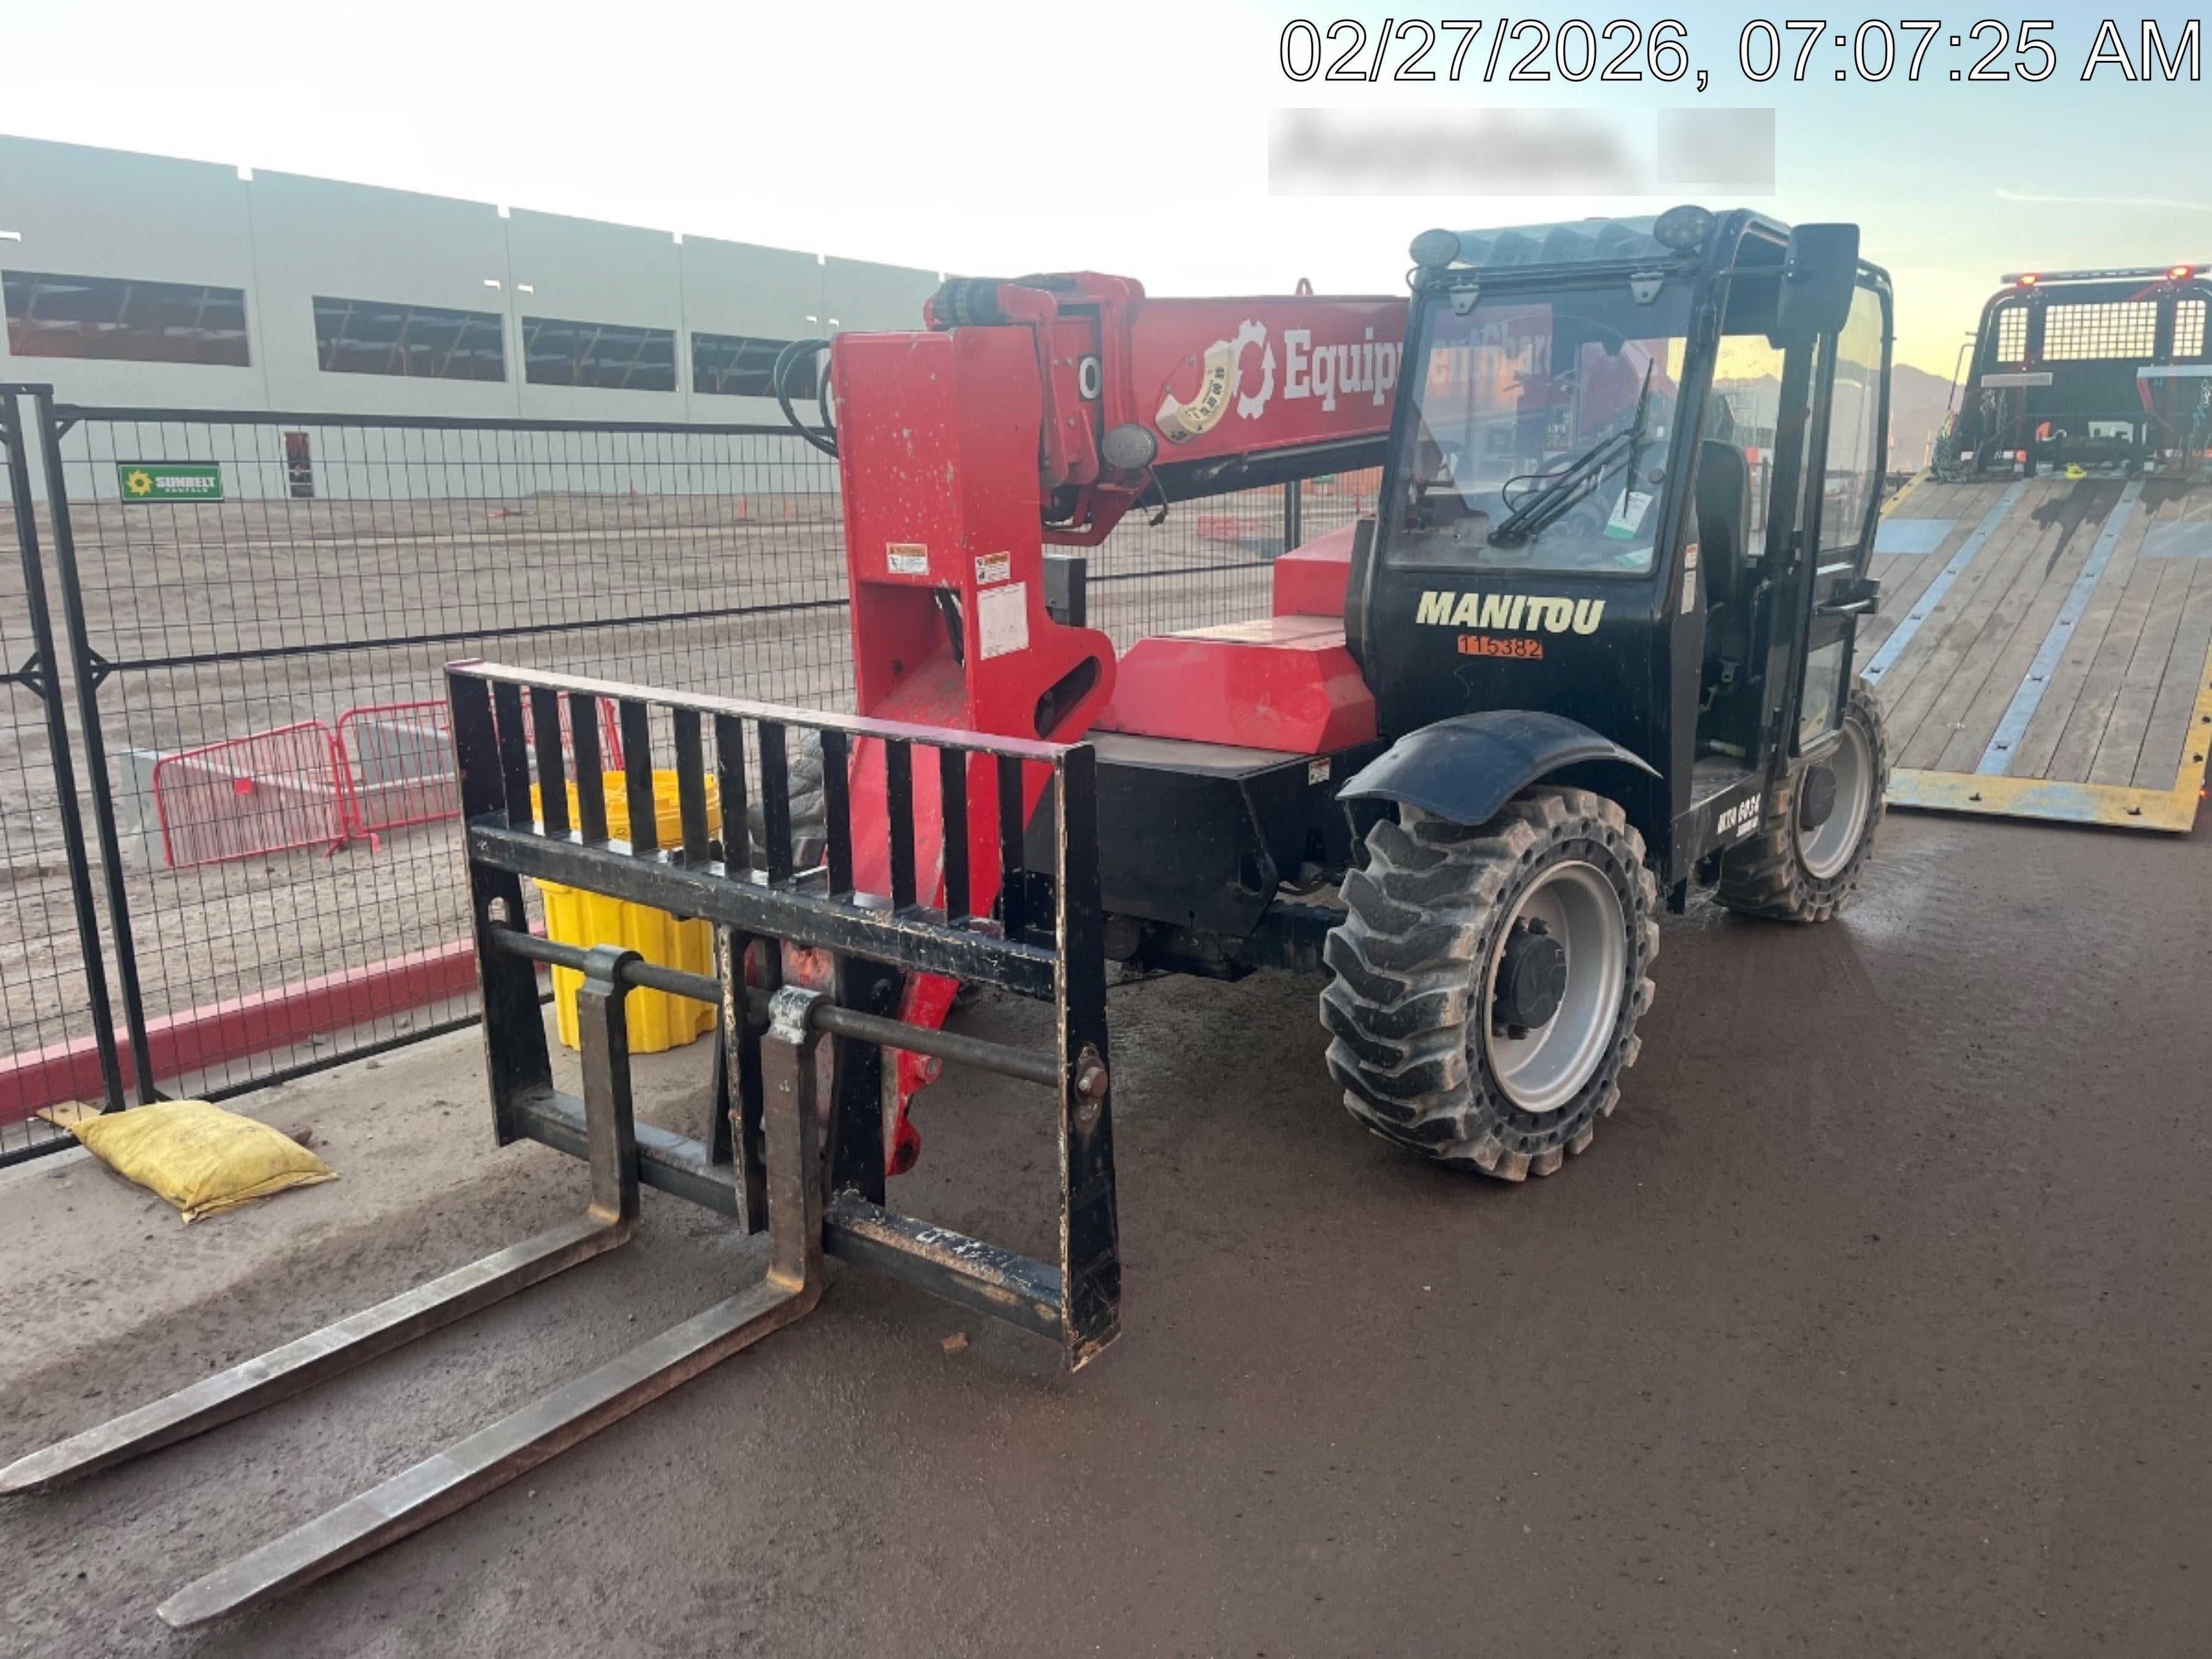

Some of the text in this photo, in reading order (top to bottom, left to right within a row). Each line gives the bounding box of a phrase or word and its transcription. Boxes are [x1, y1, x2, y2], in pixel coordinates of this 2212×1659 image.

[155, 476, 216, 488] SUNBELT
[1415, 591, 1606, 635] MANITOU
[1459, 635, 1542, 657] 115382
